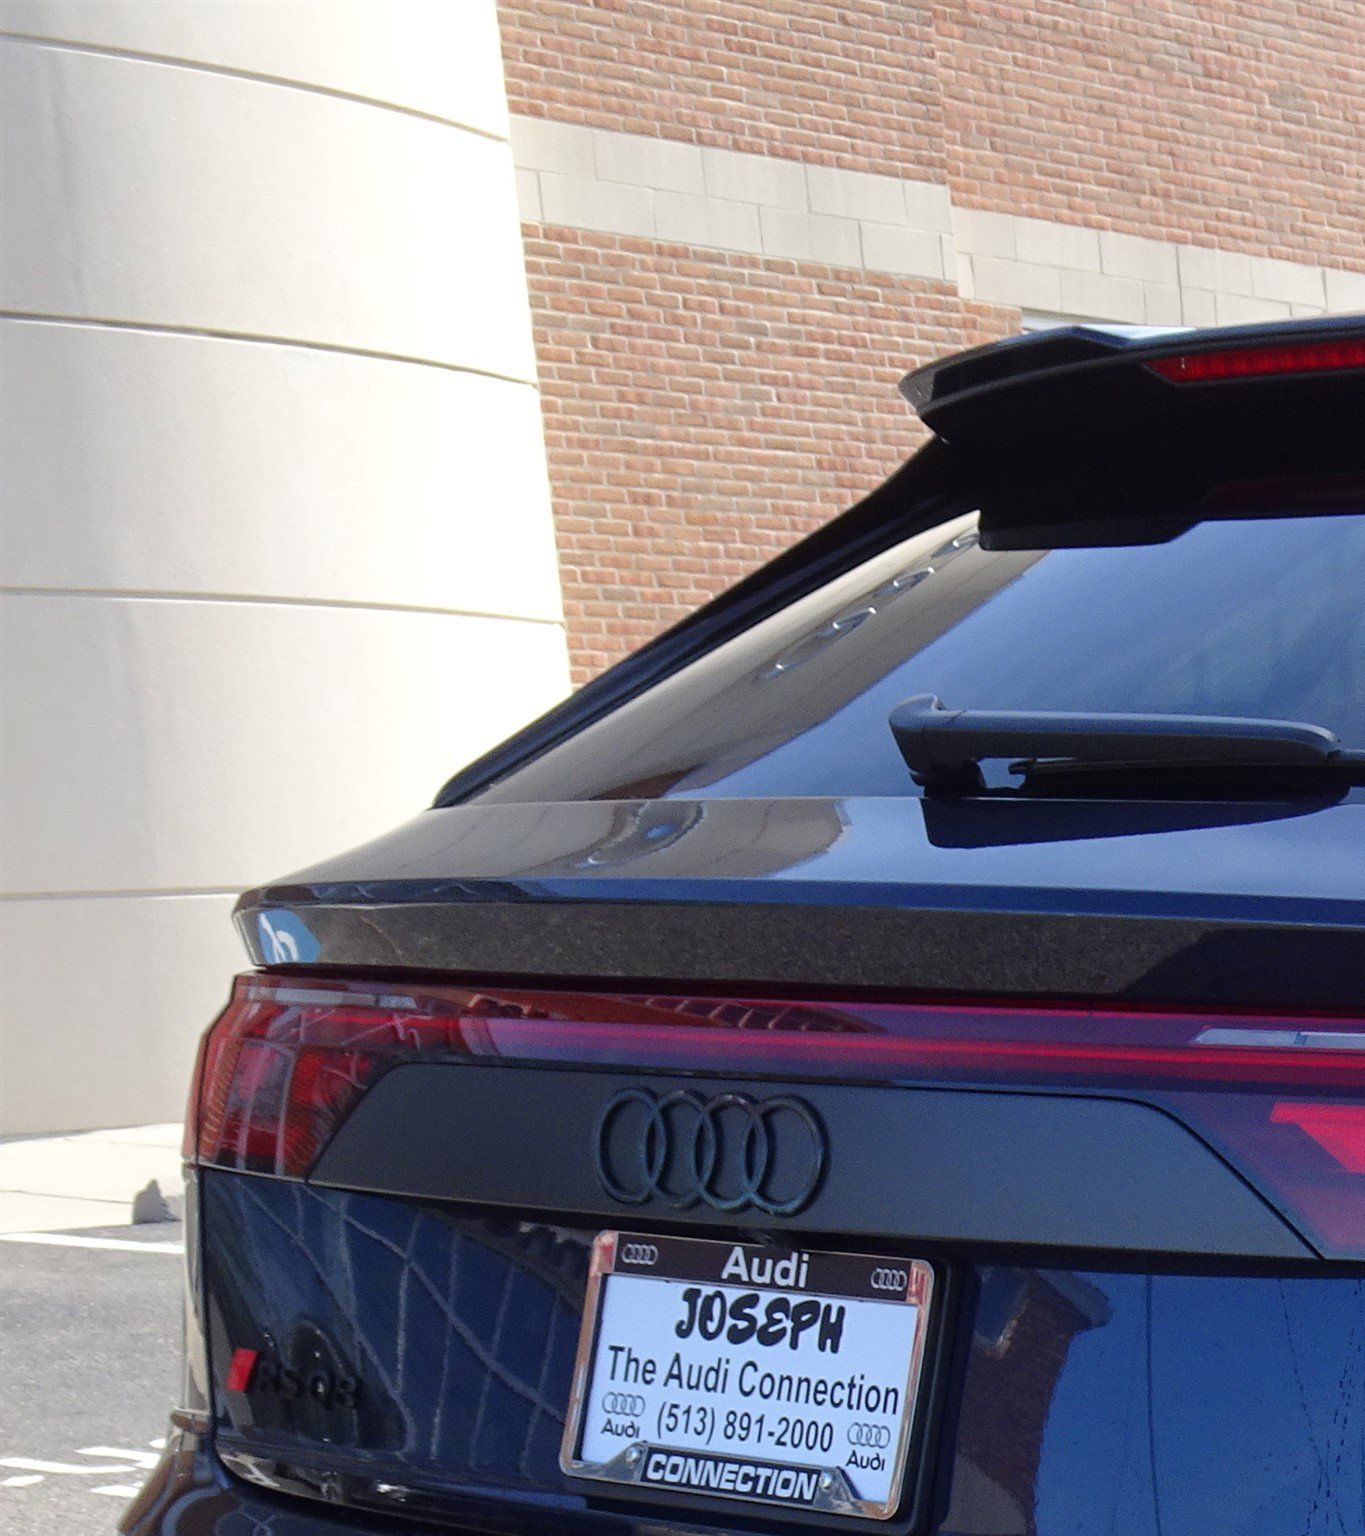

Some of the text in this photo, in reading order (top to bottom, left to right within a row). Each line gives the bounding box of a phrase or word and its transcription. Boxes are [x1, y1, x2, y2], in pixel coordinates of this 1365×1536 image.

[721, 1246, 809, 1288] Audi
[676, 1287, 846, 1353] JOSEPH
[608, 1345, 899, 1415] The Audi Connection
[602, 1418, 640, 1439] Audi
[657, 1401, 833, 1452] (513) 891-2000
[647, 1454, 819, 1500] CONNECTION
[846, 1450, 886, 1471] Audi
